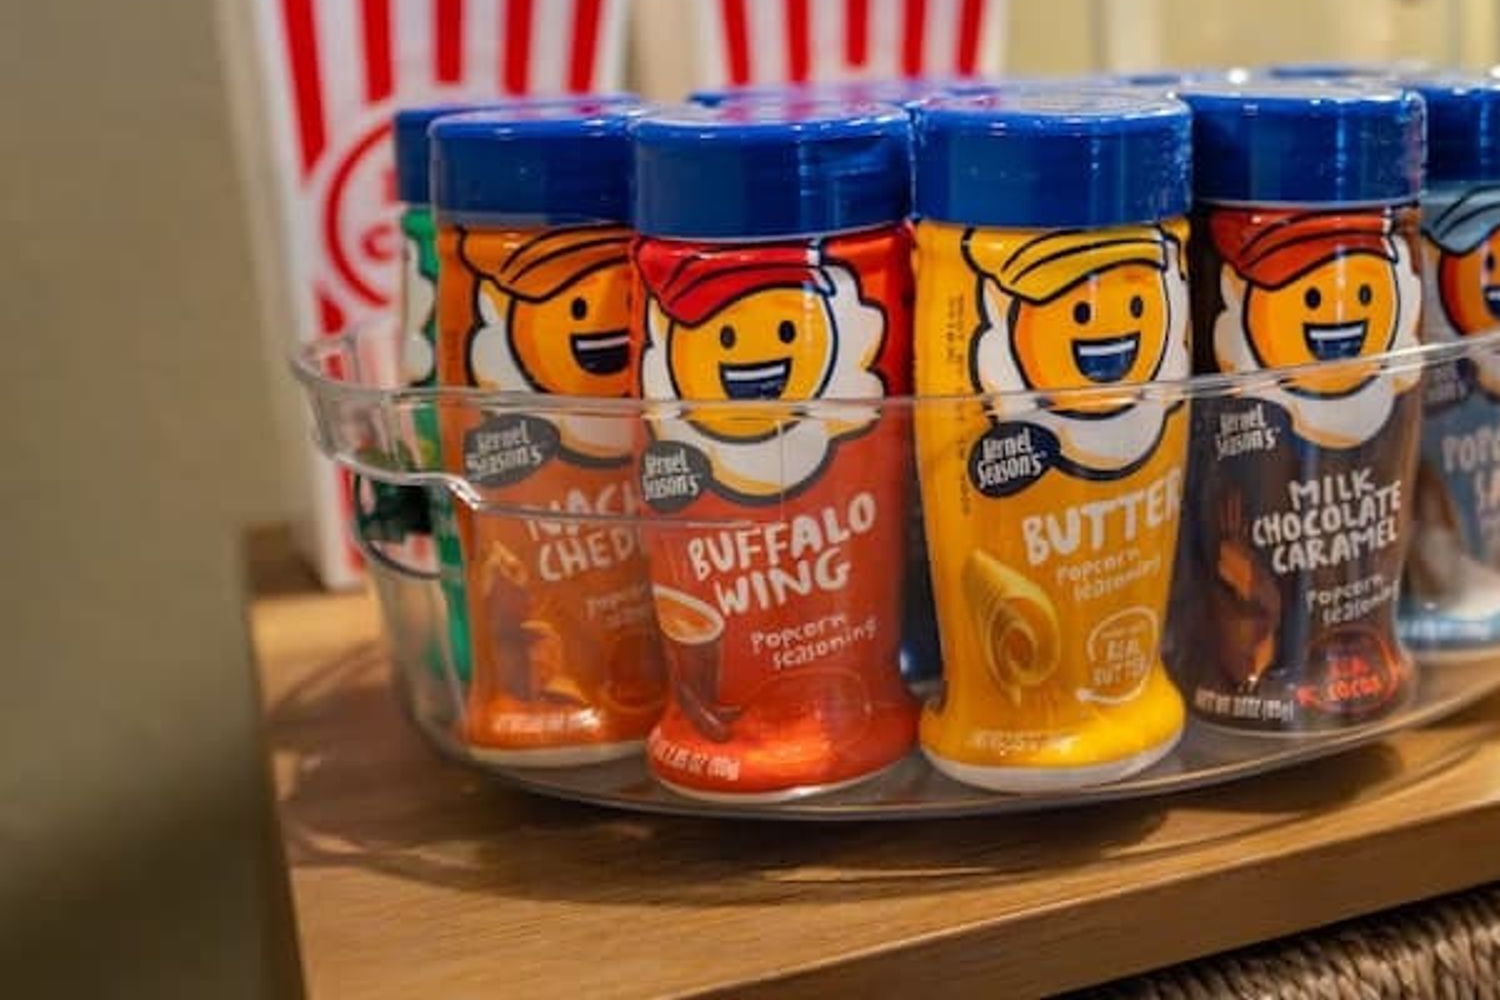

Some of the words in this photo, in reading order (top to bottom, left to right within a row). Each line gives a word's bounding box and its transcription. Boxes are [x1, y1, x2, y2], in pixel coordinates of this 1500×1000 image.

[1022, 468, 1182, 566] BUTTER
[1252, 479, 1401, 547] CHOCOLATE
[1288, 468, 1376, 511] MILK
[688, 493, 876, 582] BUFFALO
[1272, 518, 1398, 574] CARAMEL
[715, 547, 852, 616] WING
